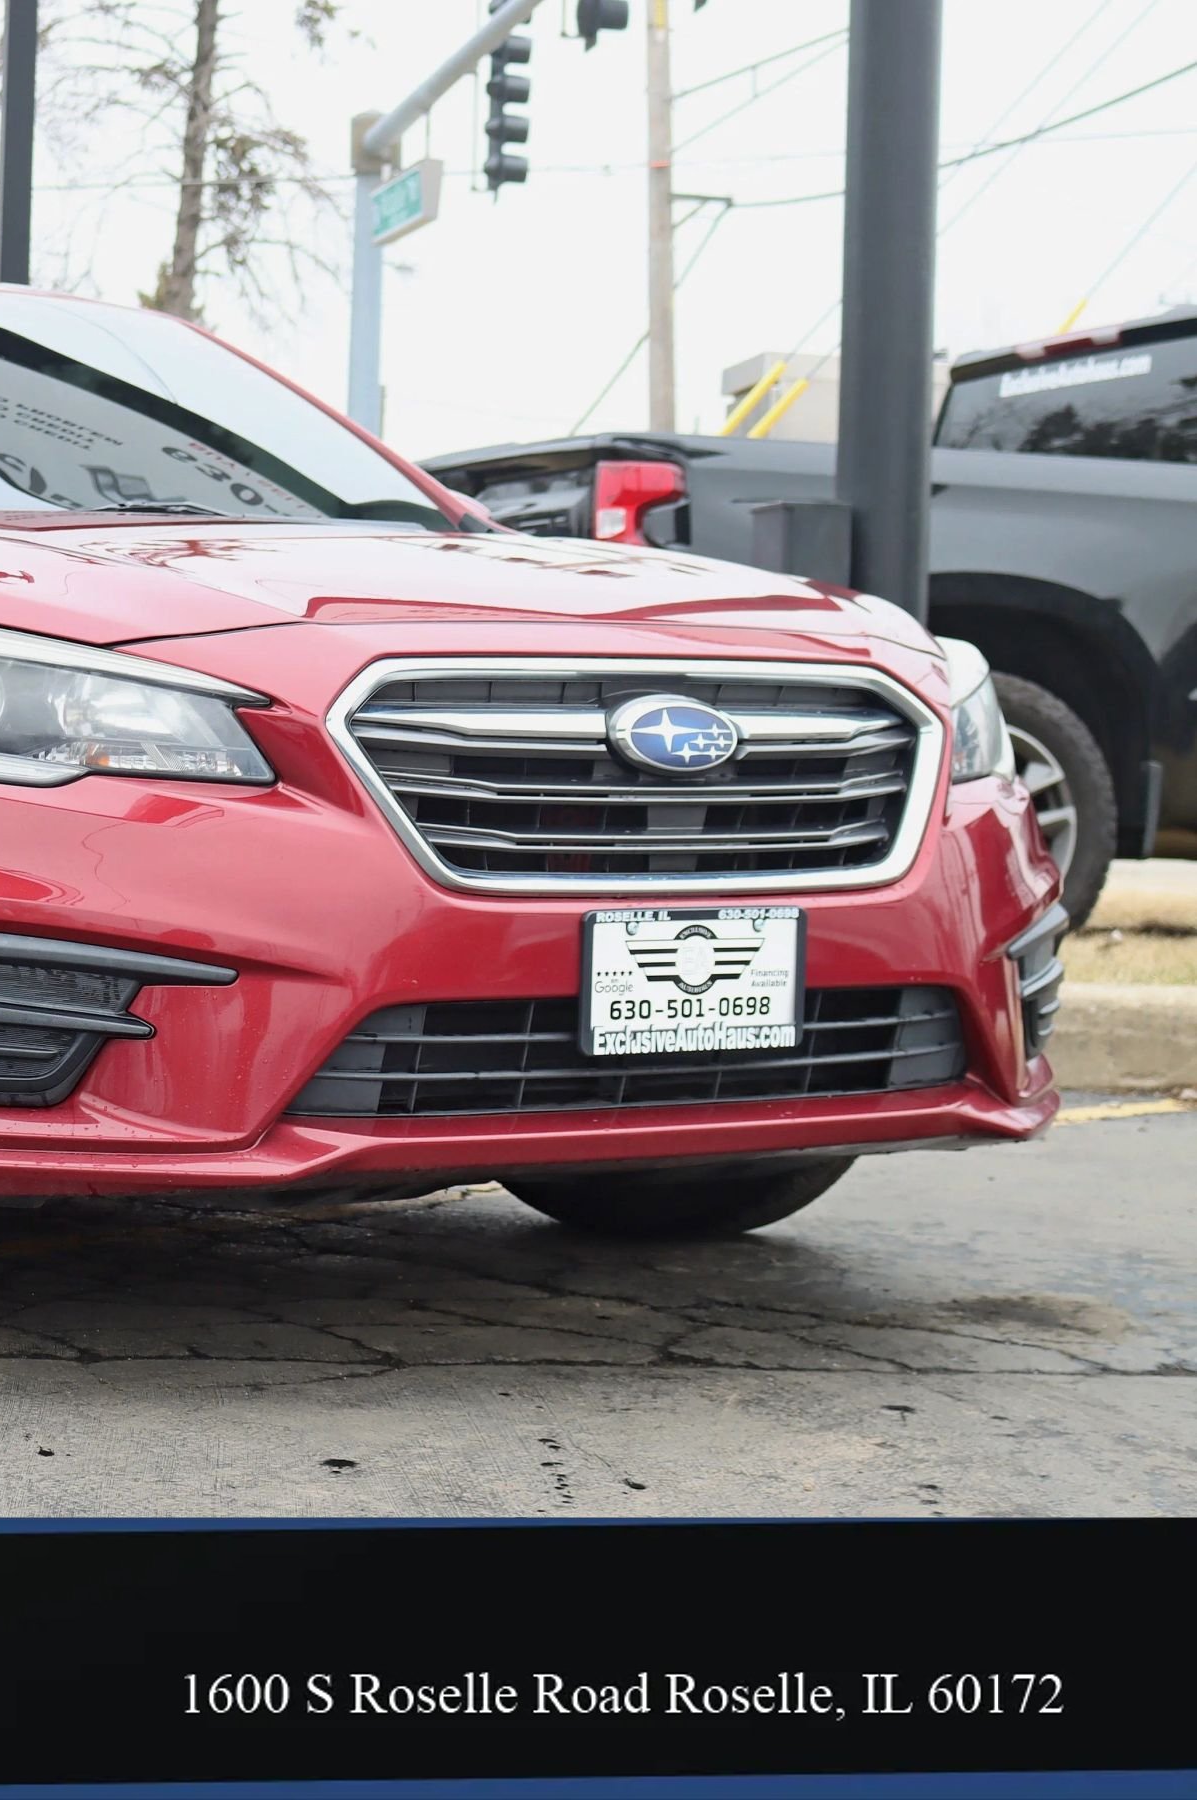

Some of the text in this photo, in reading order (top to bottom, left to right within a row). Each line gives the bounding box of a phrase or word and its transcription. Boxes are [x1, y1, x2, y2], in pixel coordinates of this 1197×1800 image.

[596, 911, 671, 923] ROSELLE, IL
[718, 907, 799, 919] 630-501-0698
[751, 969, 789, 979] Financing
[594, 981, 633, 996] Google
[751, 979, 787, 988] Available
[610, 996, 771, 1020] 630-501-0698
[593, 1022, 796, 1055] ExclusiveAutoHaus.com
